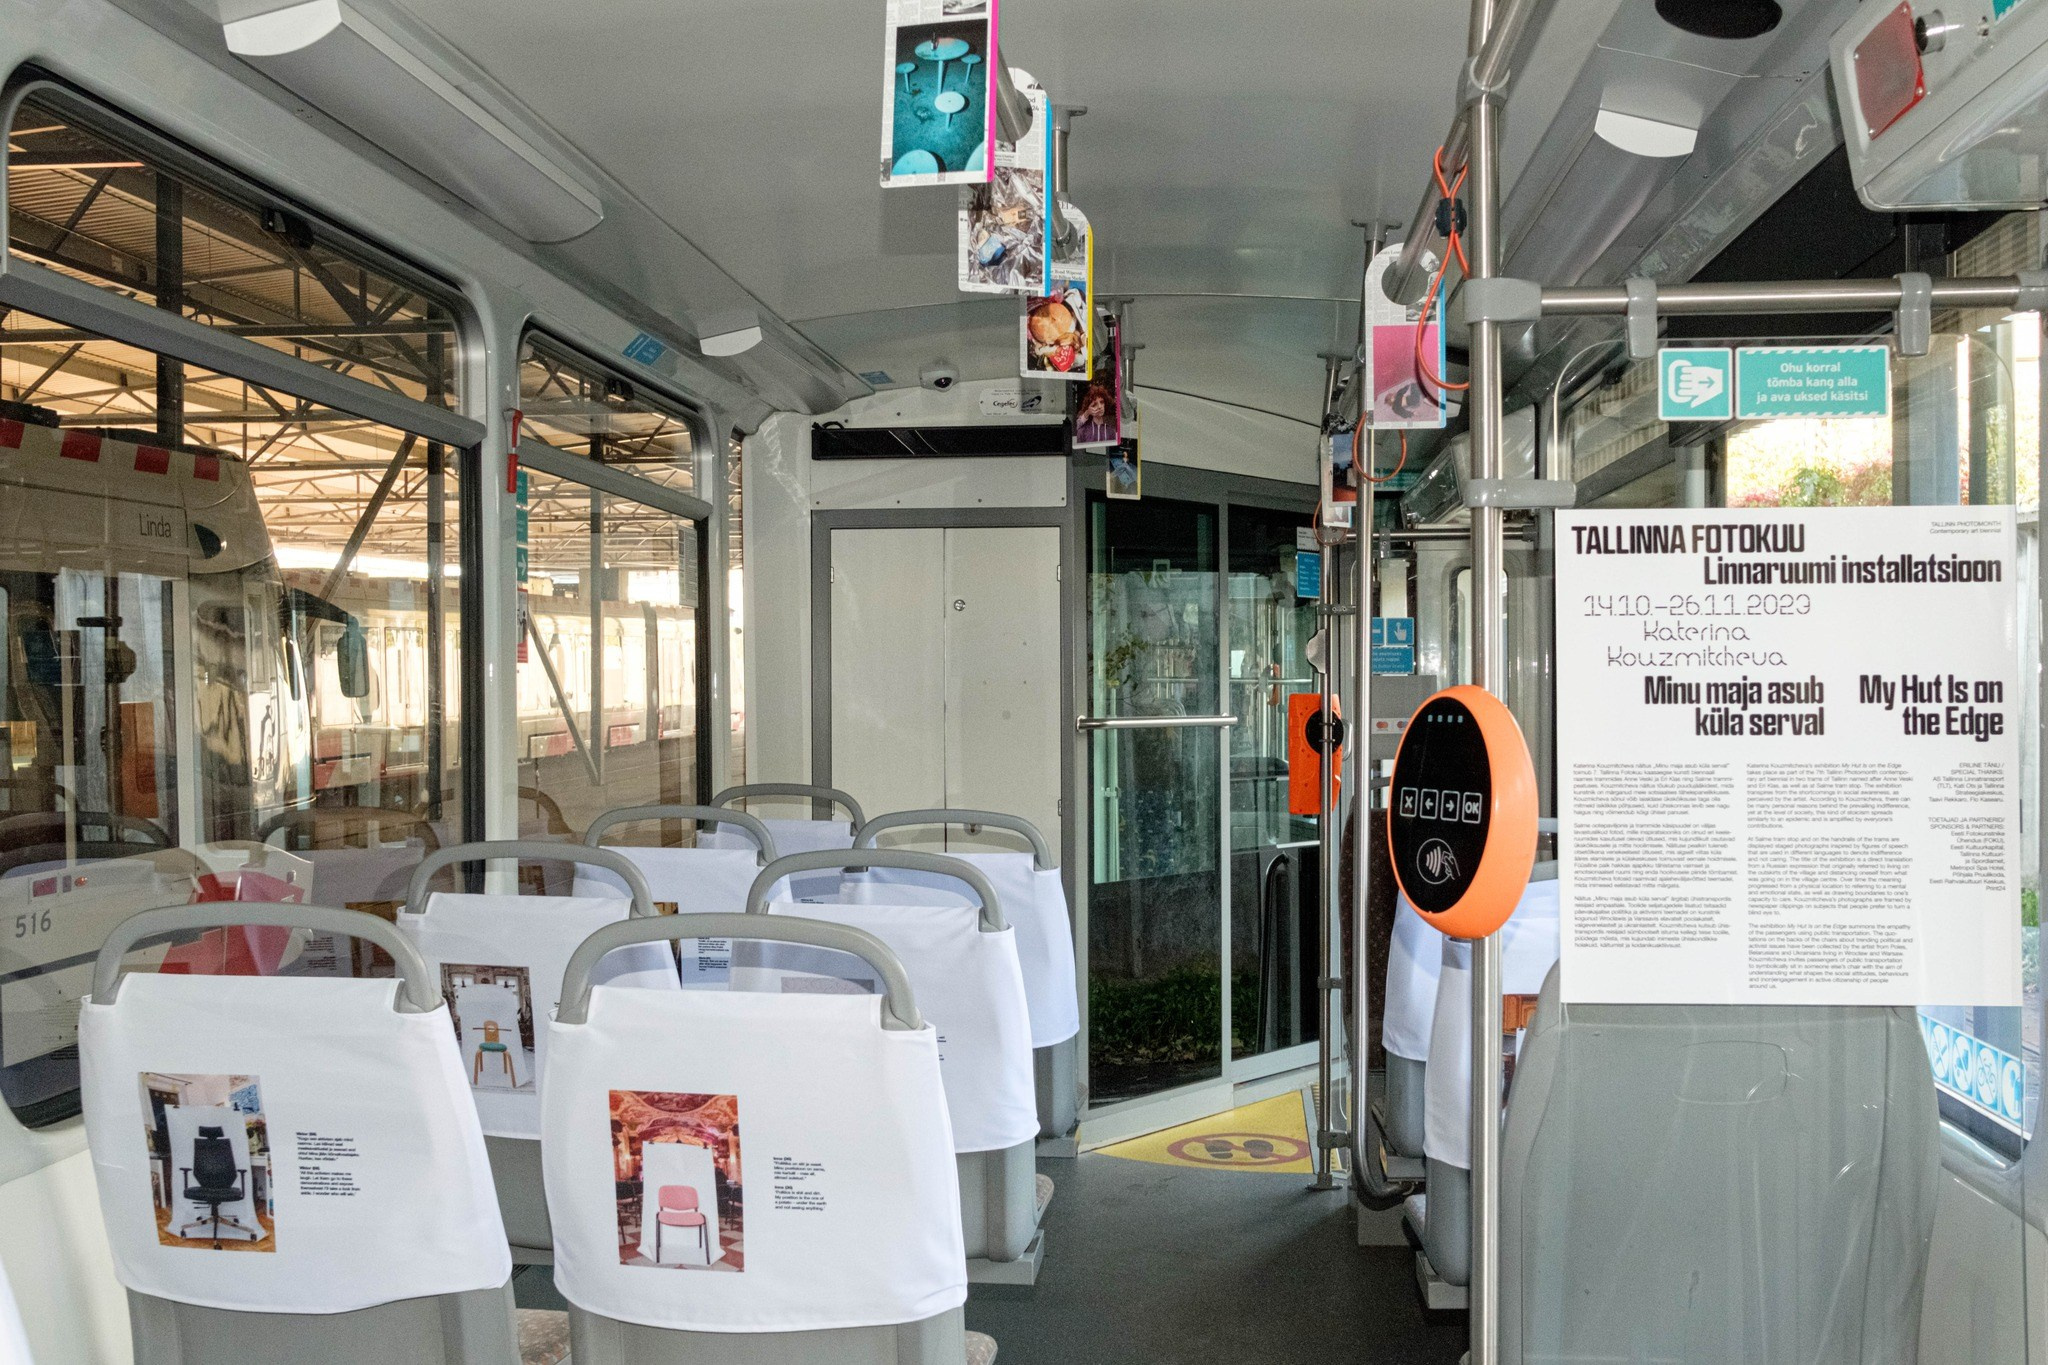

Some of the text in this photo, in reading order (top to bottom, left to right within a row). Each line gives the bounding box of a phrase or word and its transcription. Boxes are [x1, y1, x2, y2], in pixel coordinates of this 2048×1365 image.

[1780, 362, 1840, 372] Ohu korral
[1767, 376, 1857, 389] tõmba kang alla
[1756, 392, 1766, 404] ja
[1794, 391, 1827, 401] uksed
[1831, 390, 1868, 400] käsitsi
[139, 514, 172, 538] Linda
[1572, 524, 1804, 554] TALLINNA FOTOKUU
[1704, 554, 2002, 584] Linnaruumi installatsioon
[1643, 620, 1750, 641] Katerina
[1608, 646, 1787, 666] Kouzmitcheva
[1644, 676, 1824, 710] Minu maja asub
[1860, 674, 2003, 710] My Hut Is on
[1695, 706, 1824, 736] küla serval
[1904, 706, 2003, 741] the Edge
[1465, 802, 1479, 814] OK
[15, 910, 51, 938] 516
